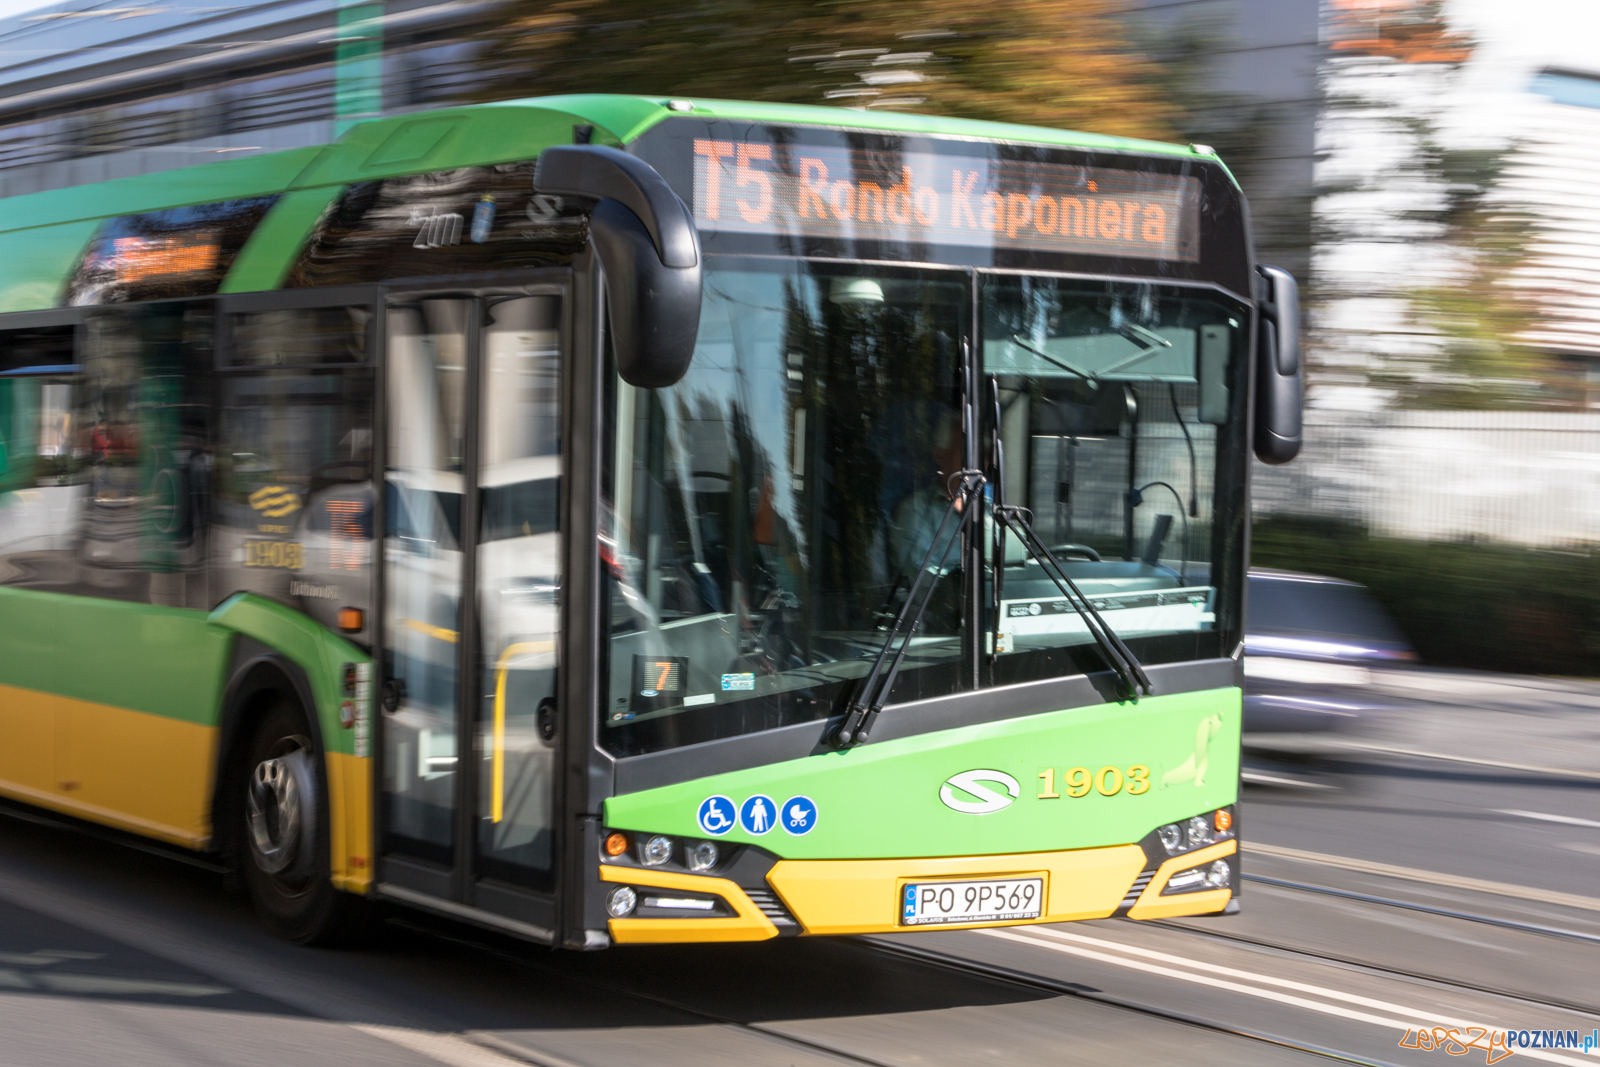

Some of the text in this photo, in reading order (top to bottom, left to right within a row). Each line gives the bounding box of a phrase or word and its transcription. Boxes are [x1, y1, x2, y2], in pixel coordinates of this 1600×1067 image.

[693, 139, 1166, 243] T5 Rondo Kaponiera
[243, 541, 307, 569] 1903
[655, 661, 672, 691] 7
[1036, 764, 1151, 800] 1903
[905, 905, 915, 914] PL
[920, 883, 1036, 915] PO 9P569
